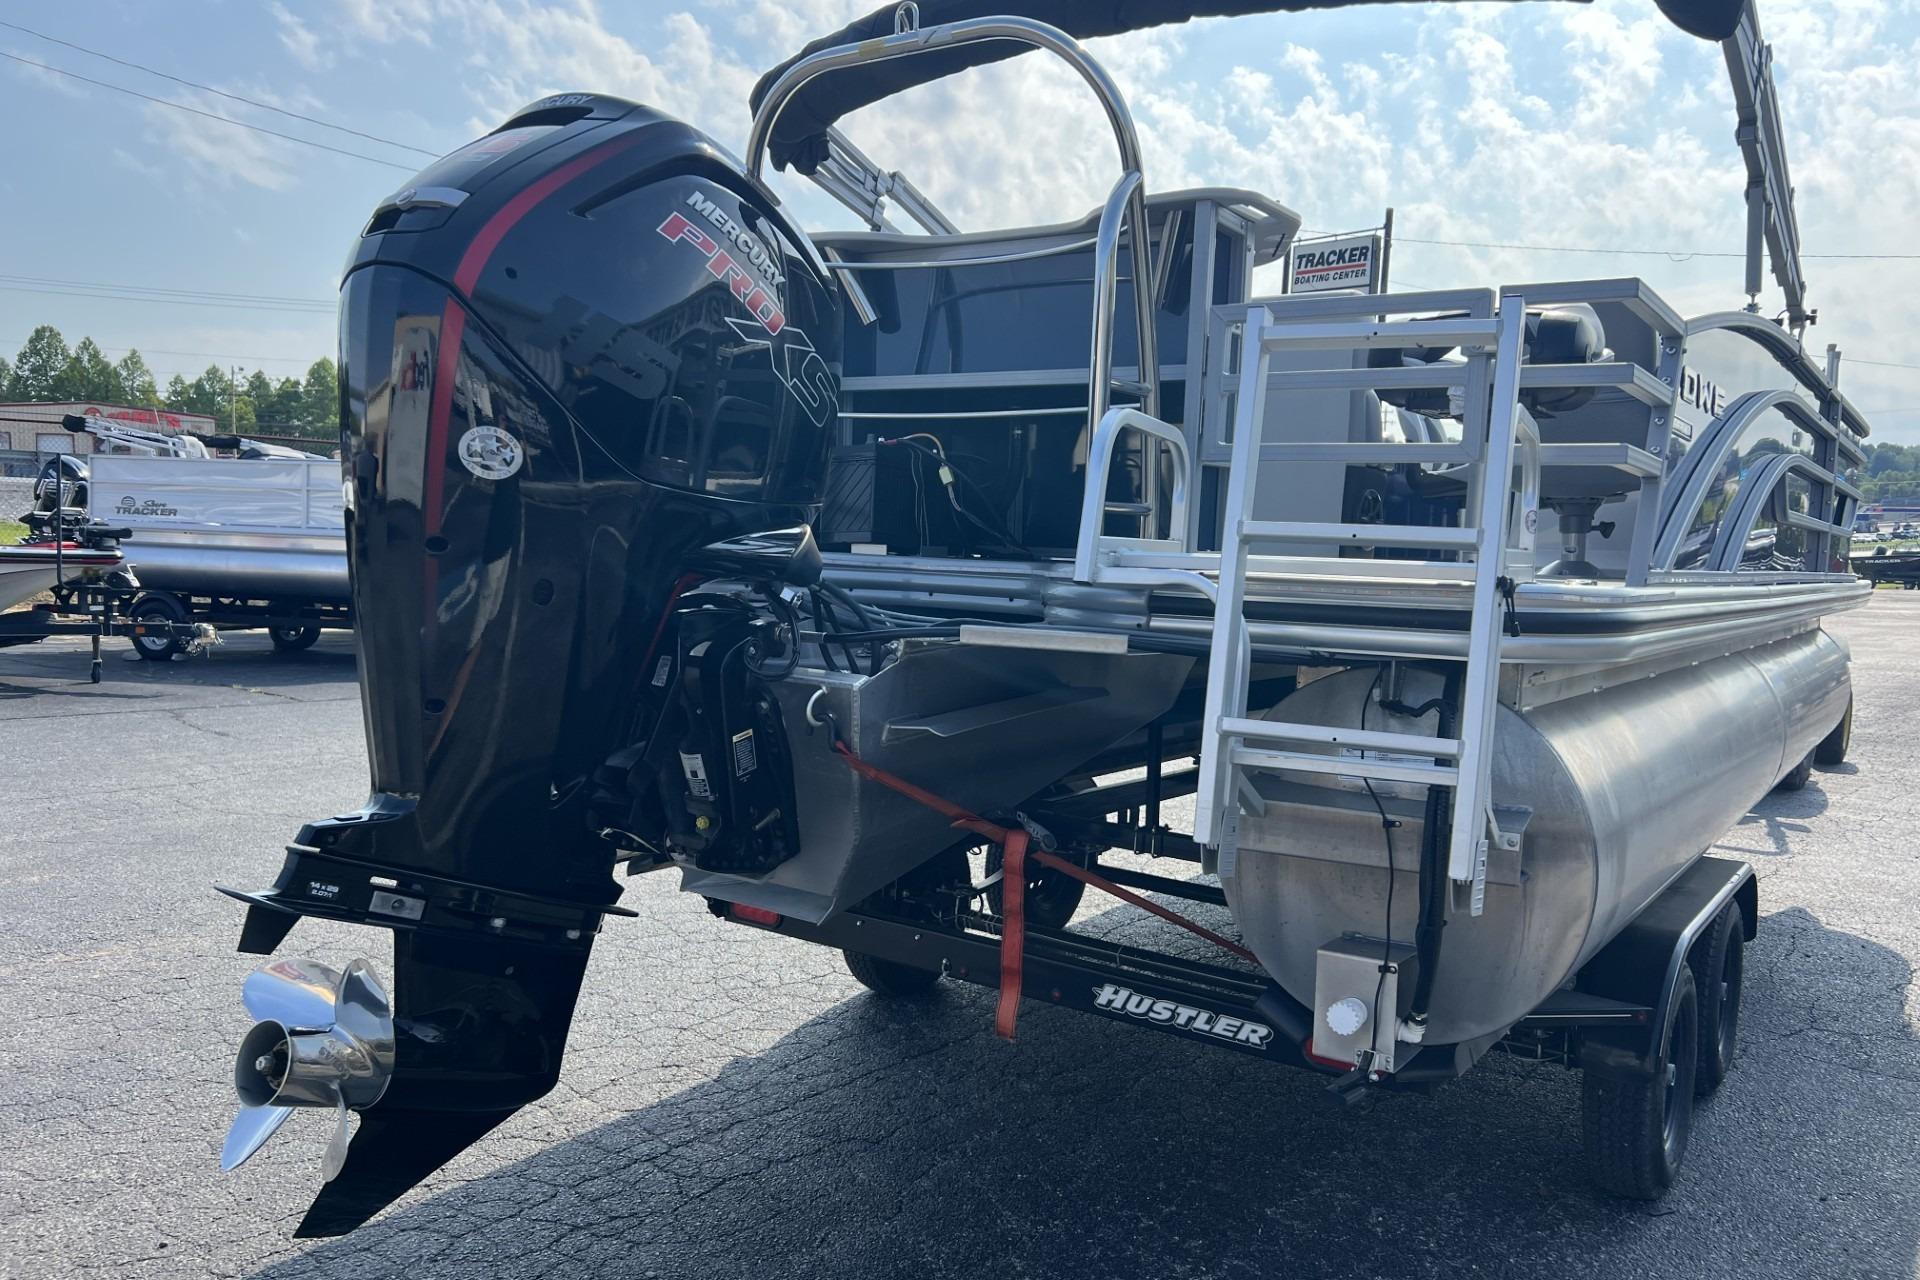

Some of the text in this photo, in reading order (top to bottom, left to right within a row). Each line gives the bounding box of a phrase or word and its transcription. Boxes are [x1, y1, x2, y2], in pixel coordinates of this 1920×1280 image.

[685, 190, 786, 287] MERCURY
[1296, 246, 1370, 269] TRACKER
[1294, 269, 1367, 285] BOATING CENTER
[656, 211, 839, 427] PRO XS
[1680, 365, 1727, 421] OWE
[115, 506, 178, 516] TRACKER
[1094, 983, 1272, 1047] HUSTLER
